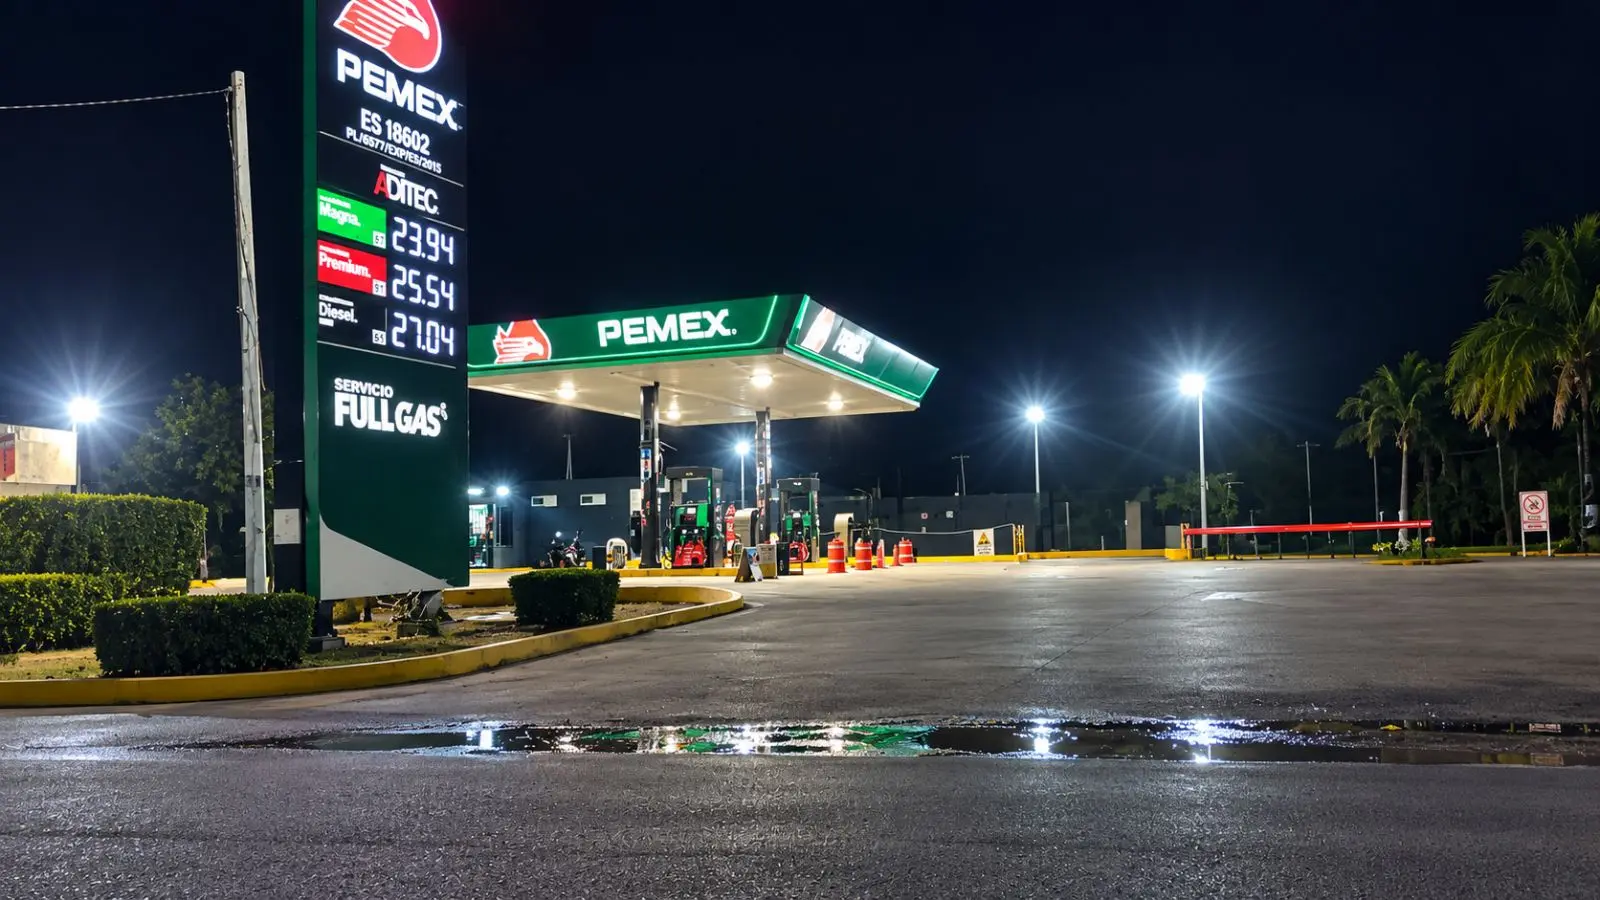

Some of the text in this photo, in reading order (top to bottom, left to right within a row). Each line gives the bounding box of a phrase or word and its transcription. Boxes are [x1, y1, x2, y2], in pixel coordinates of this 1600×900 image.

[337, 47, 458, 131] PEMEX
[360, 107, 430, 156] ES 18602
[373, 170, 439, 215] ADITEC
[392, 216, 454, 265] 23.94
[392, 264, 454, 311] 25.54
[392, 312, 454, 356] 27.04
[597, 308, 732, 347] PEMEX
[334, 377, 394, 399] SERVICIO
